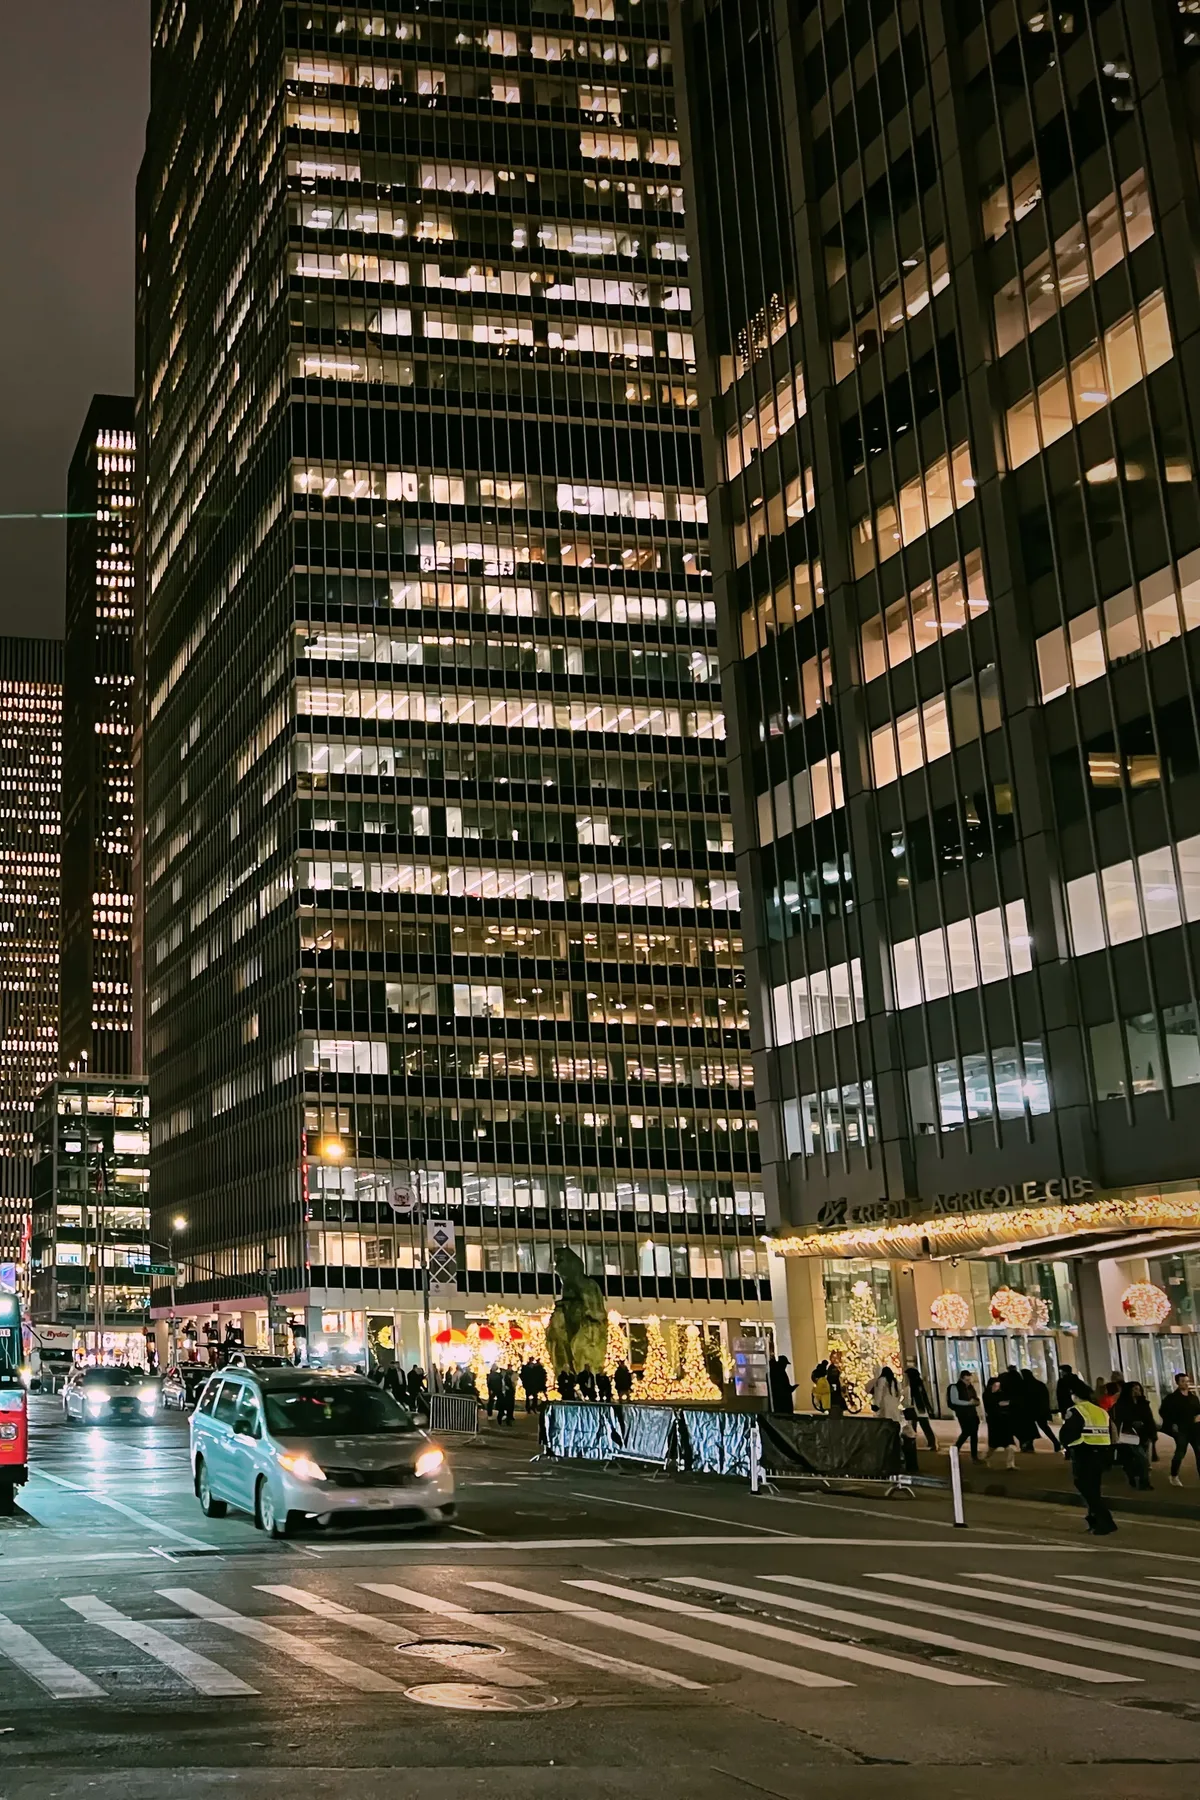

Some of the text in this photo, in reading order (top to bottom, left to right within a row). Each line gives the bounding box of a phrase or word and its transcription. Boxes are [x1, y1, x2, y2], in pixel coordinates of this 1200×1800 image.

[931, 1181, 1038, 1213] AGRICOLE
[1045, 1175, 1088, 1200] CIB
[46, 1330, 70, 1338] Ryder
